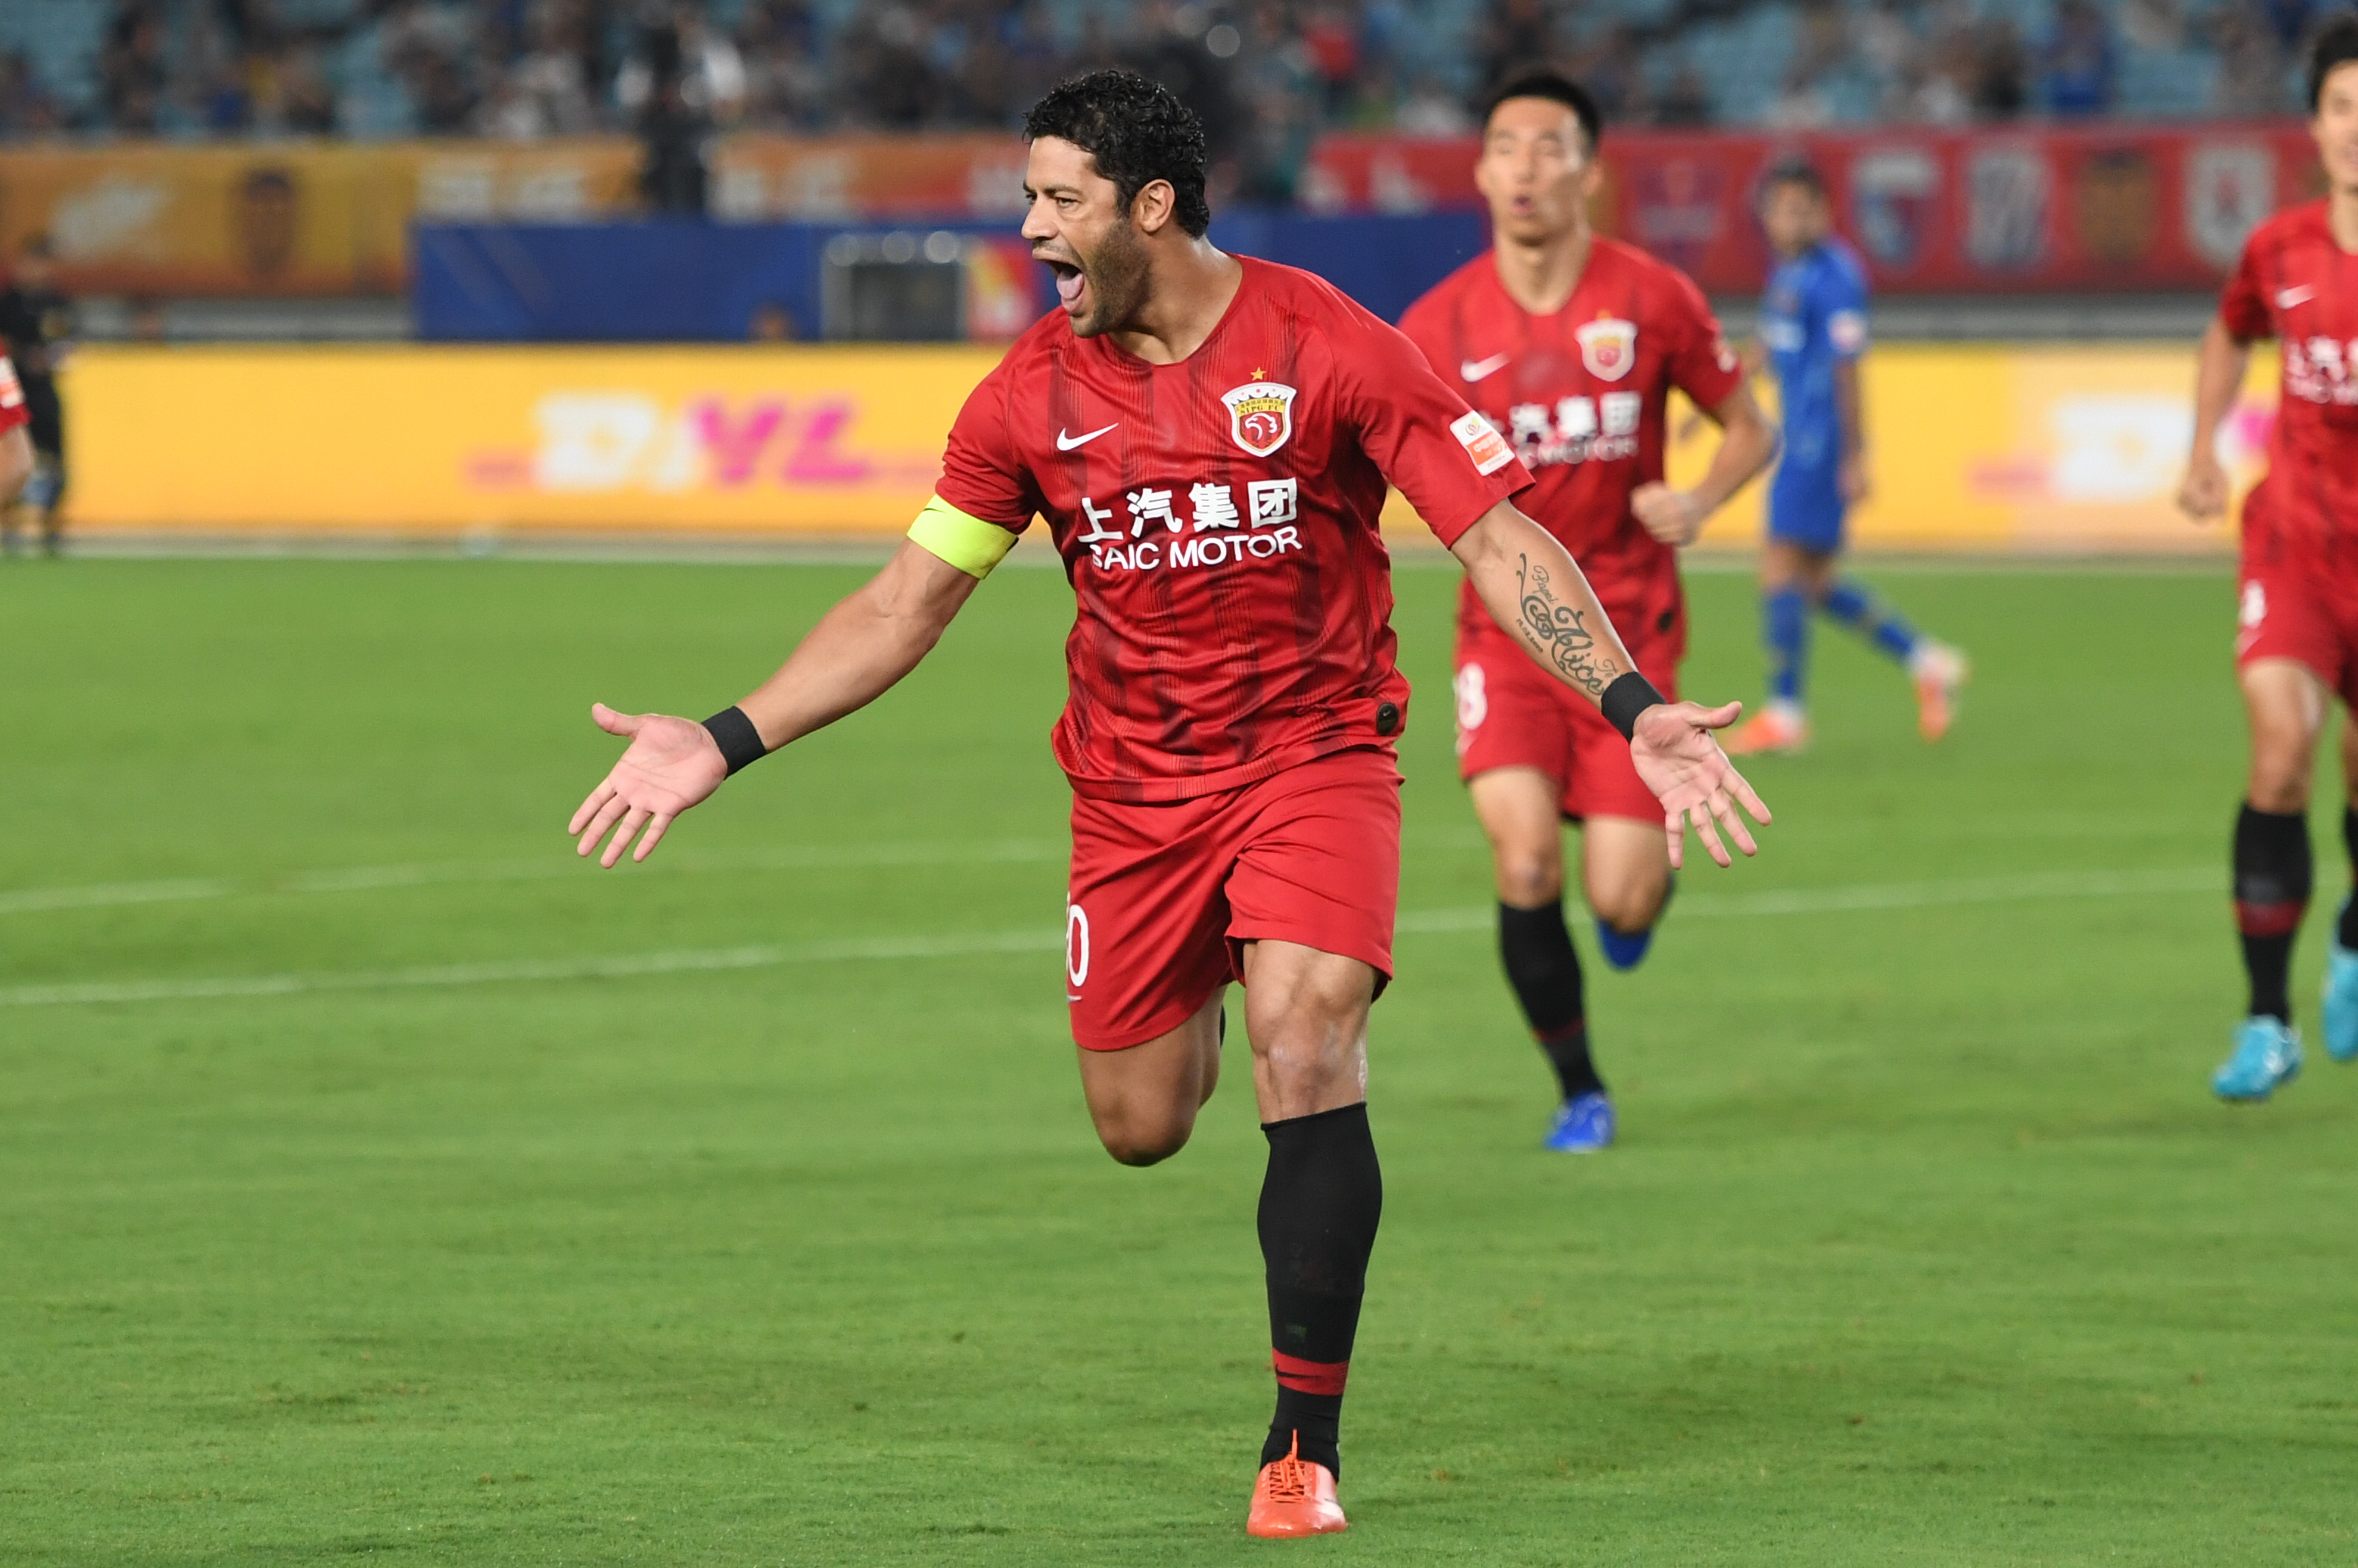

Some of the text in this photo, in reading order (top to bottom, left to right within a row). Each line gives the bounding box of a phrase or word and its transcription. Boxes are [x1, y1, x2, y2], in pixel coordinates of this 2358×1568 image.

[1240, 405, 1263, 415] SIPG
[1077, 477, 1297, 542] 上汽集团
[1089, 526, 1302, 570] SAIC MOTOR
[1453, 661, 1488, 730] 8
[1066, 894, 1089, 987] 0
